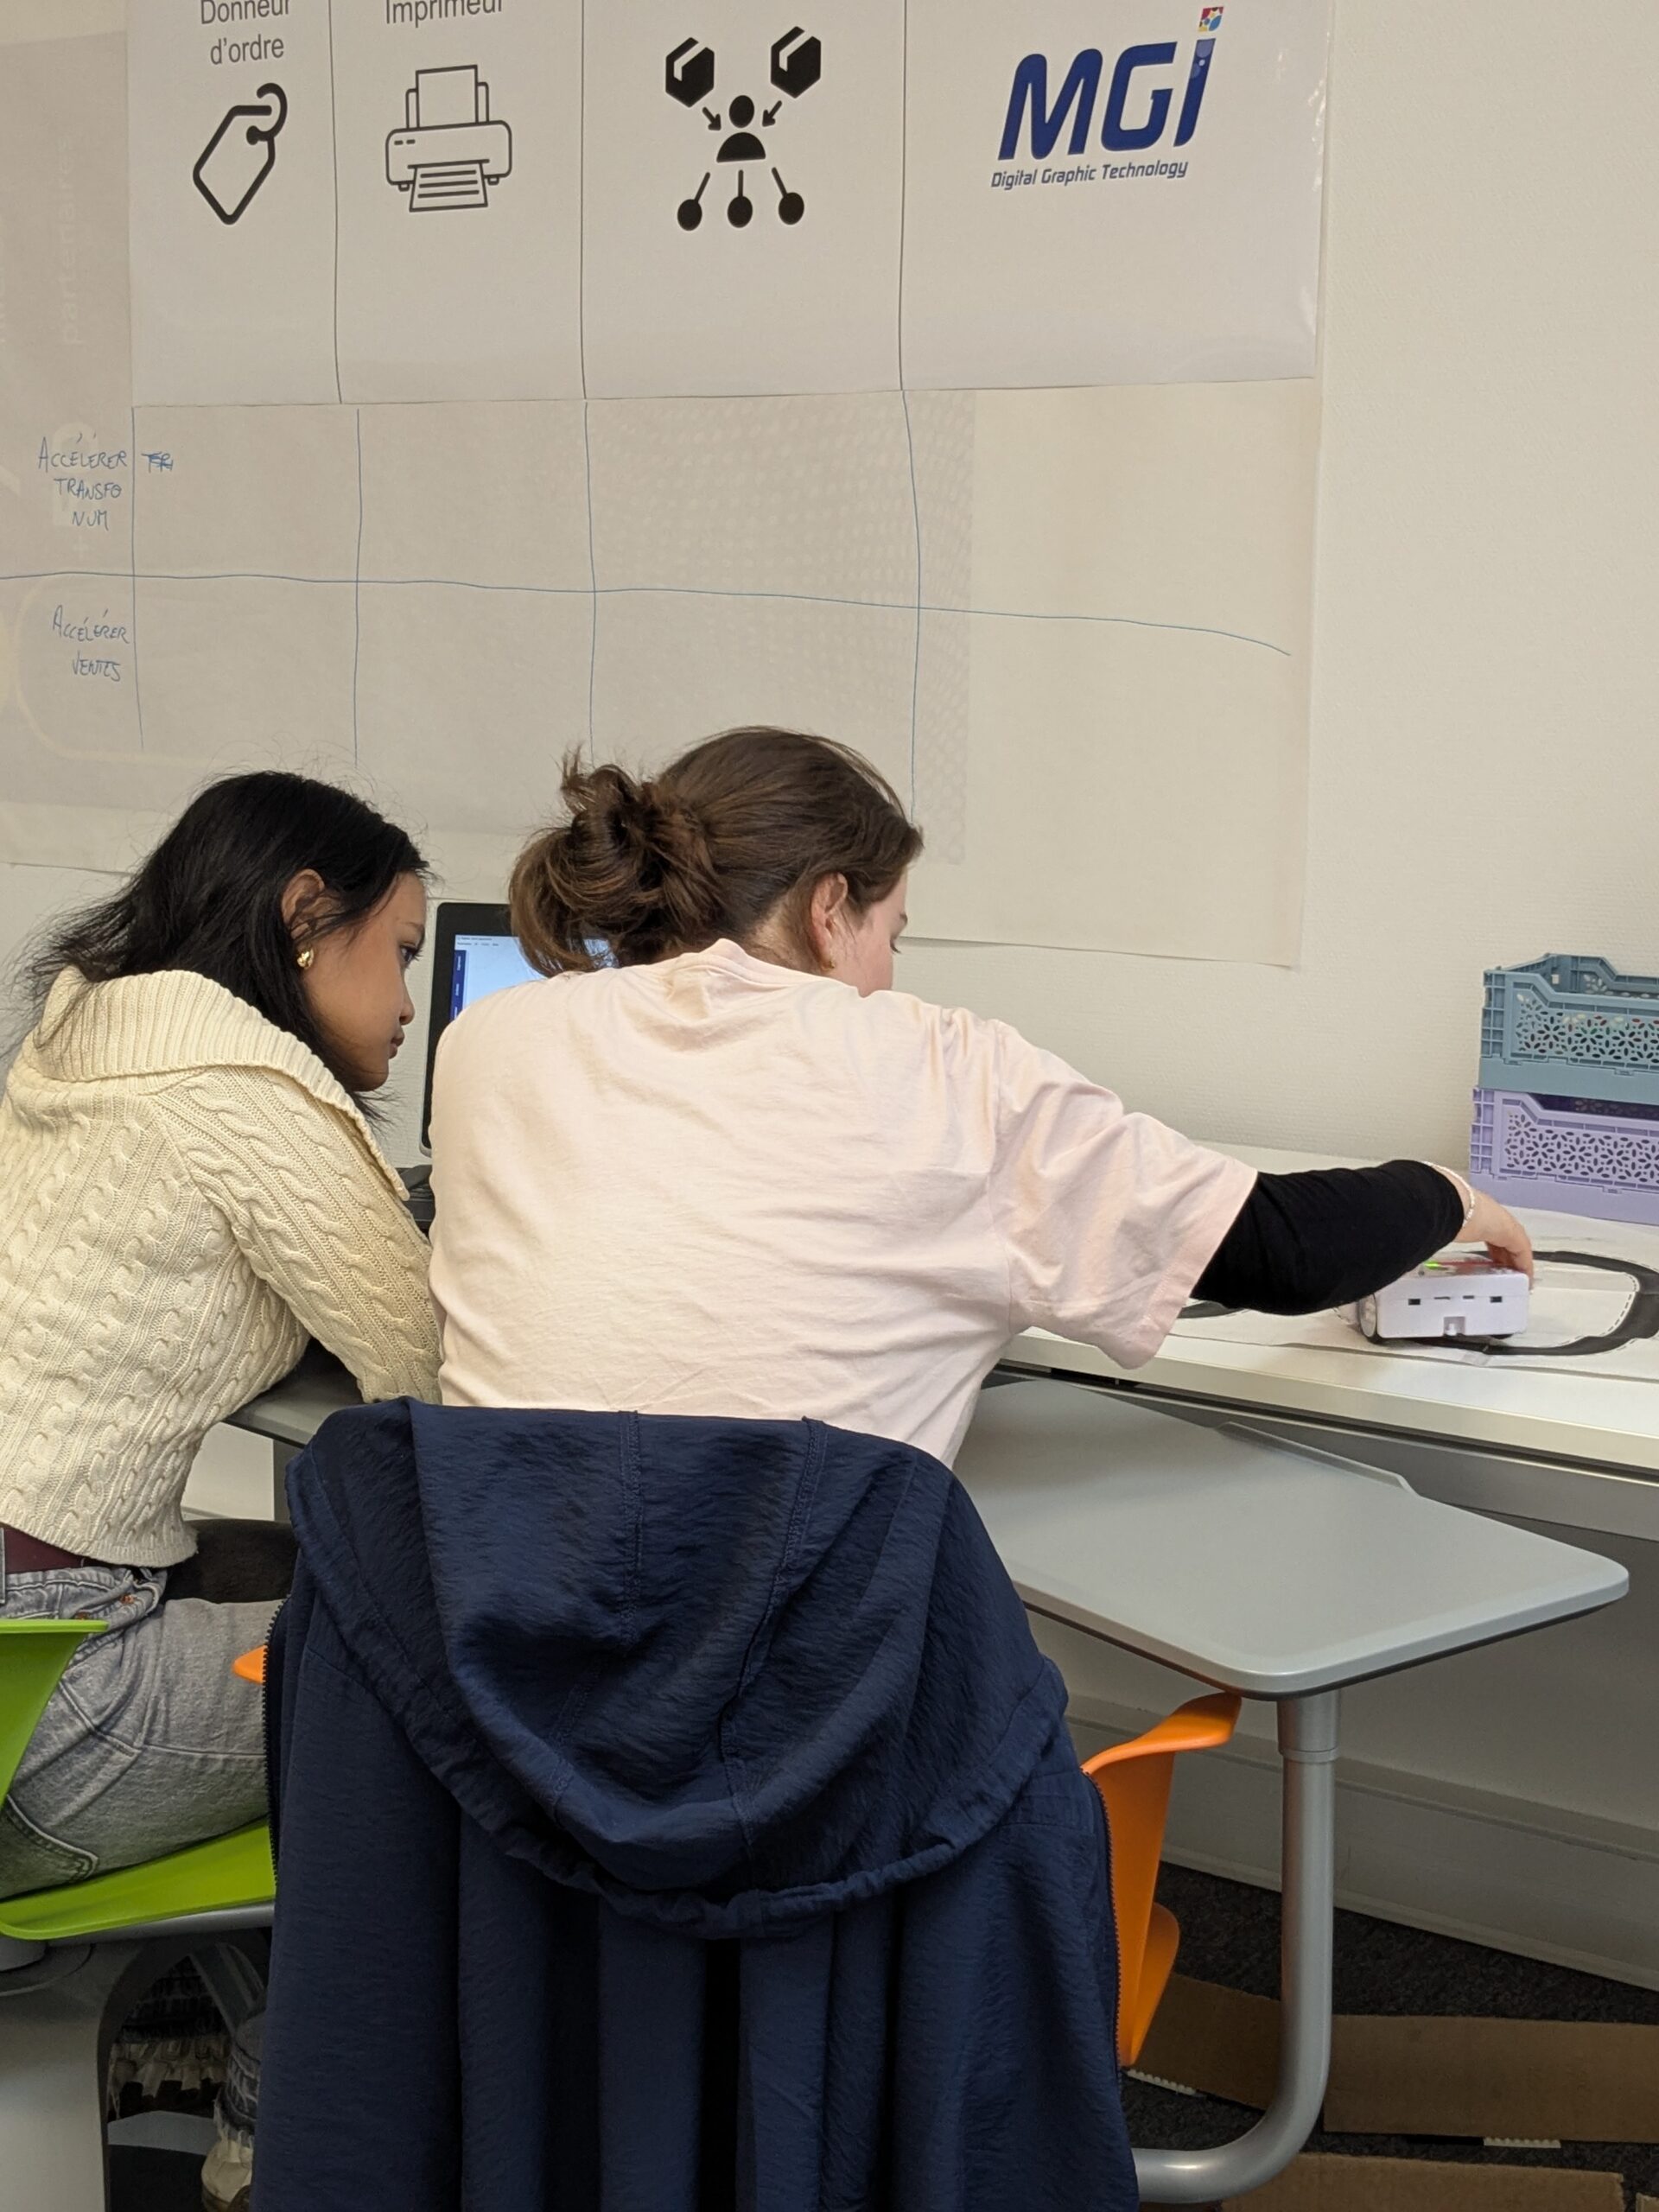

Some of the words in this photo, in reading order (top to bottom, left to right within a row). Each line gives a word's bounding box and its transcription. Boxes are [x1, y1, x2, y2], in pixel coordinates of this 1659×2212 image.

[200, 0, 289, 24] Donneur
[386, 0, 502, 29] Imprimeur
[210, 34, 284, 65] d'ordre
[990, 168, 1038, 190] Digital
[1041, 165, 1096, 187] Graphic
[1102, 160, 1189, 179] Technology
[54, 477, 123, 500] TRANSFO
[72, 511, 109, 531] NUM
